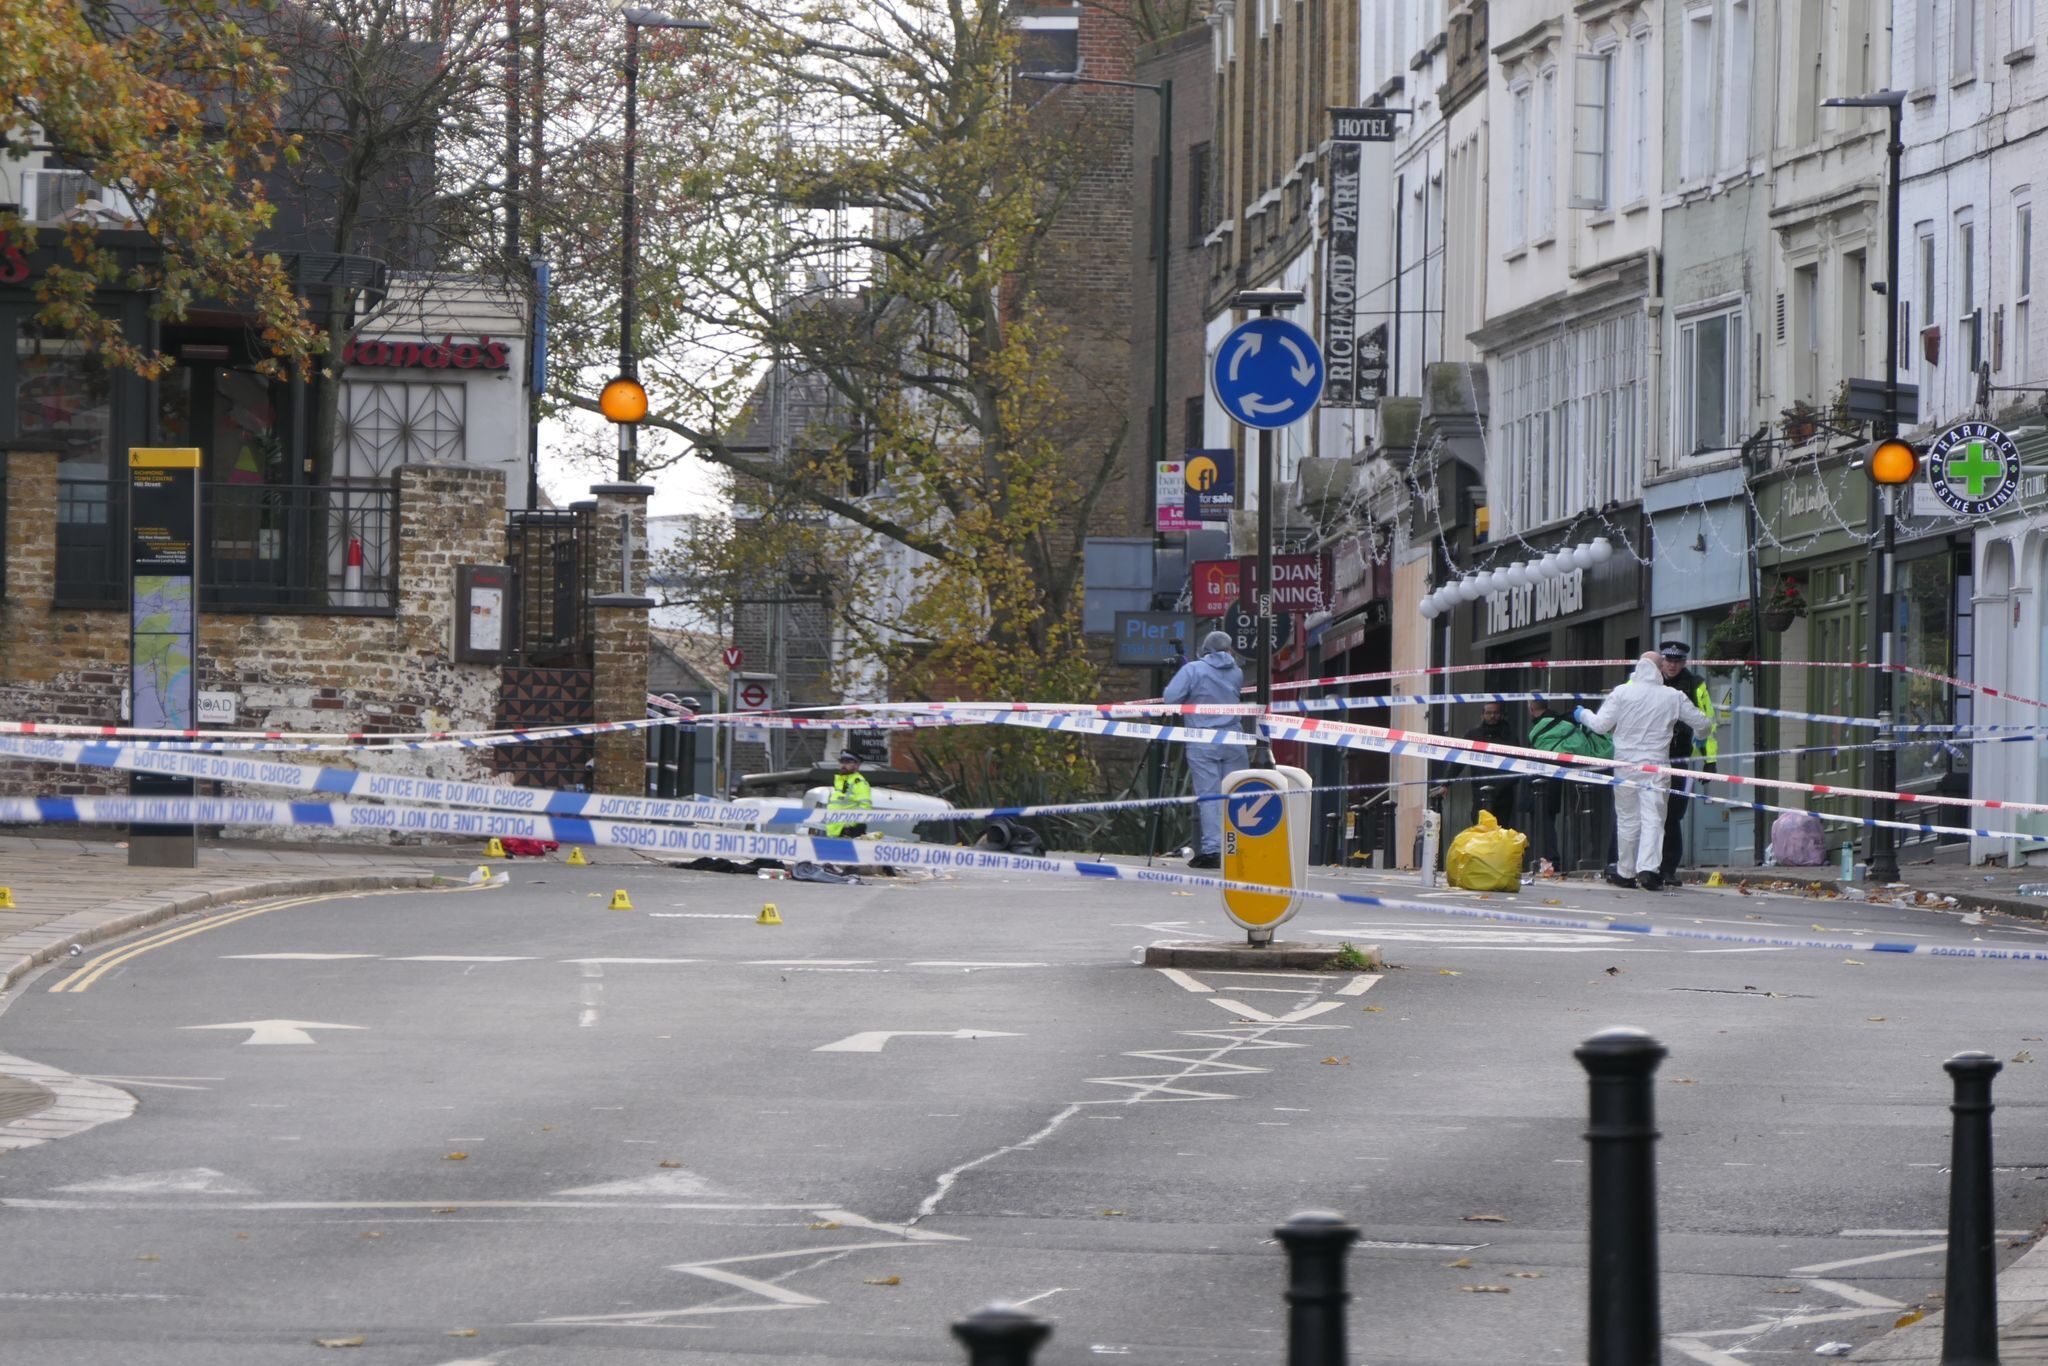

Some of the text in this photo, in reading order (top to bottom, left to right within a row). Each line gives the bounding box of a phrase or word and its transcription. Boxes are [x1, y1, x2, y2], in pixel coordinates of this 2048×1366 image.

[1338, 119, 1390, 137] HOTEL
[1333, 171, 1359, 233] PARK
[1932, 425, 2018, 463] PHARMACY
[1977, 480, 2016, 513] CLINIC
[1171, 509, 1184, 518] Le
[1252, 565, 1319, 582] IDIAN
[1486, 567, 1583, 636] THE FAT BADGER
[1127, 619, 1168, 639] Pier
[1237, 614, 1278, 628] OE
[727, 651, 739, 664] V
[351, 808, 535, 836] POLICE LINE DO NOT CROSS
[610, 825, 798, 857] POLICE LINE DO NOT CROSS
[874, 844, 1061, 873] POLICE LINE DO NOT CROSS
